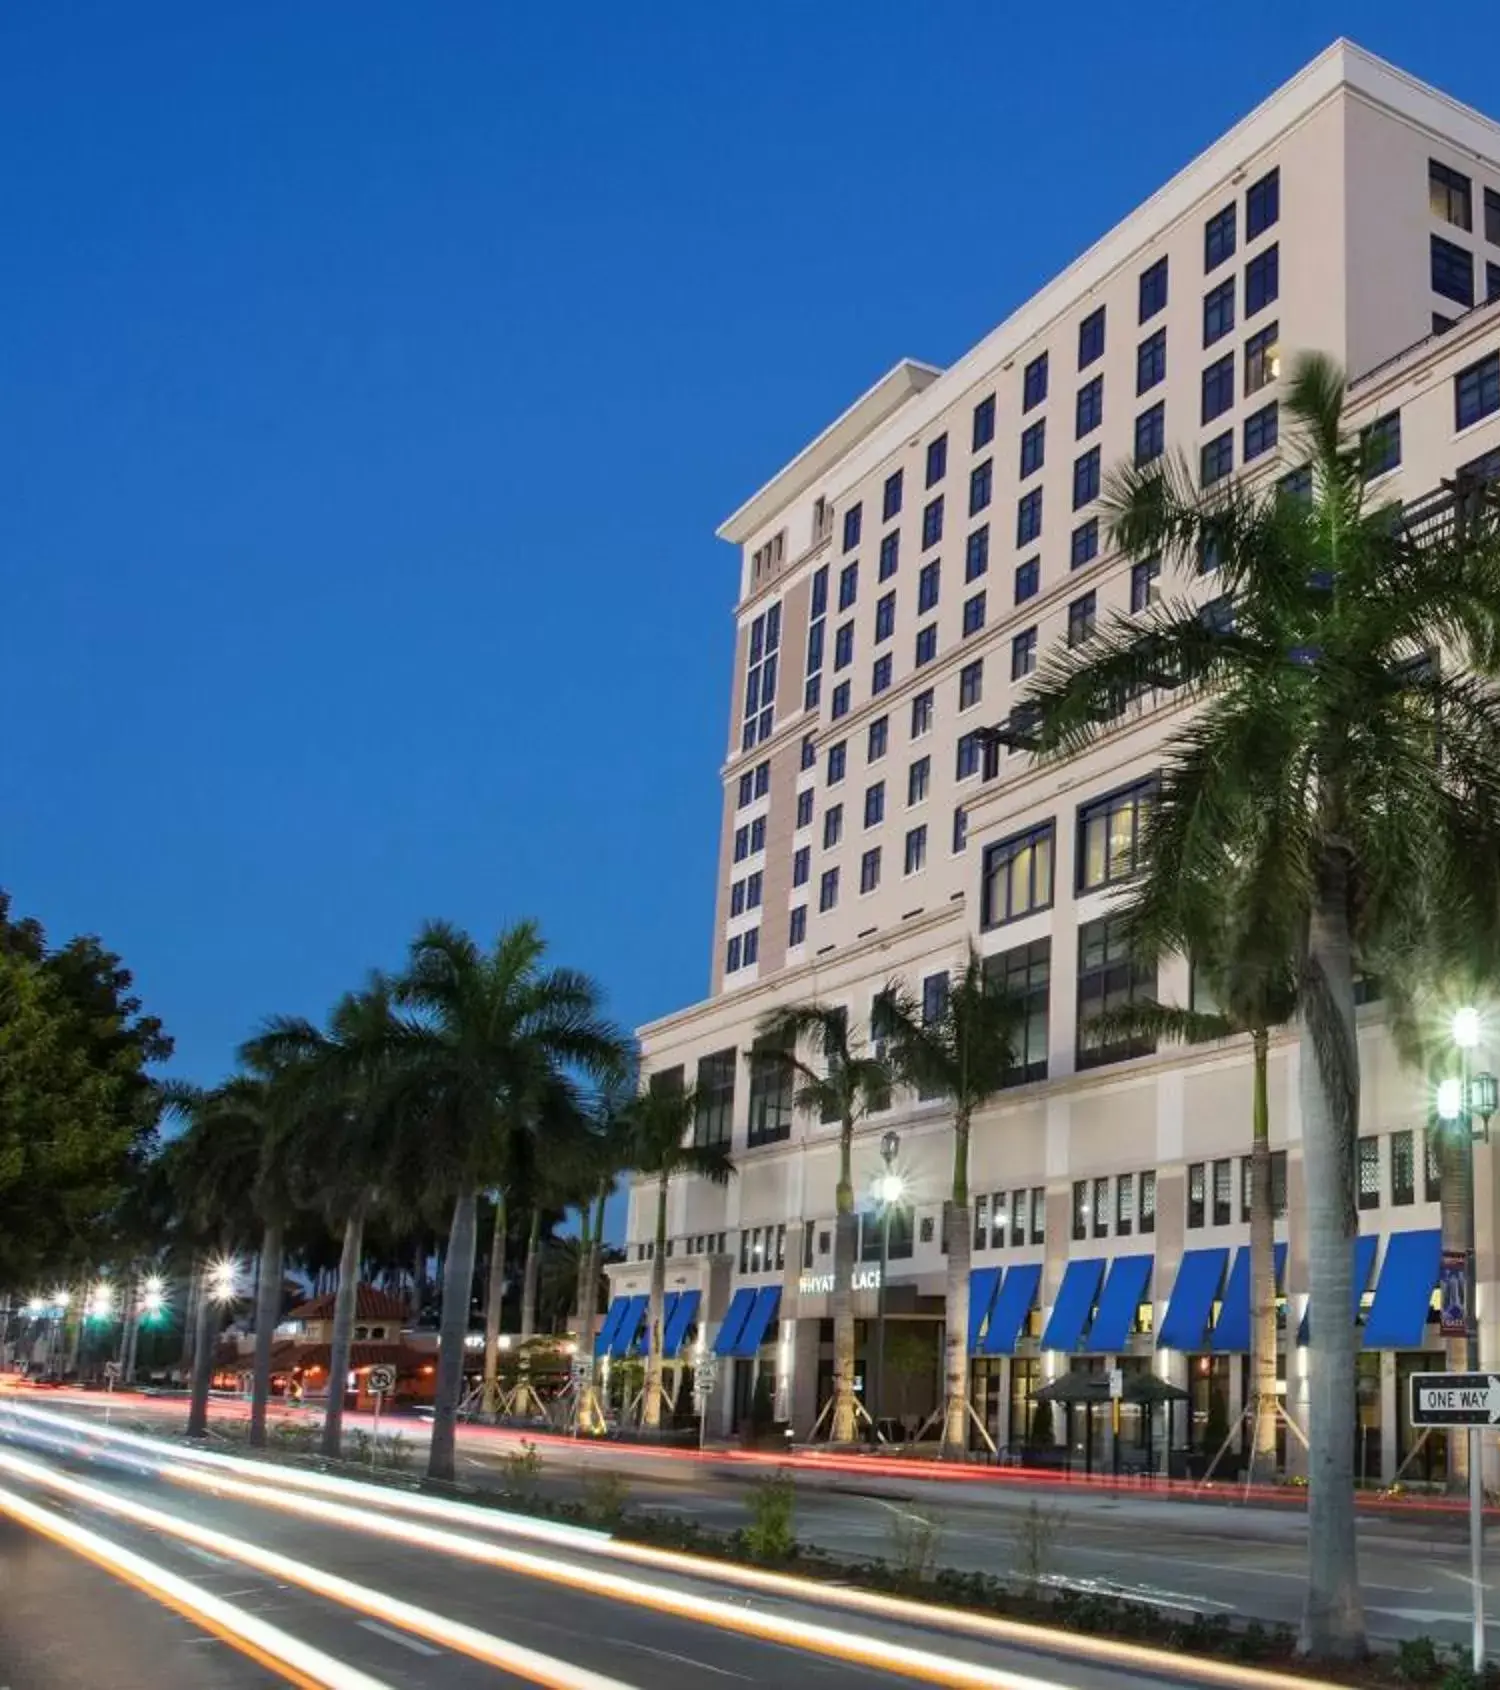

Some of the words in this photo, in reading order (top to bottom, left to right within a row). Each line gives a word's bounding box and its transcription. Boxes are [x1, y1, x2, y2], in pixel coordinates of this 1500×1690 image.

[807, 1274, 835, 1294] HYAT
[851, 1269, 881, 1292] LACE
[1427, 1391, 1456, 1408] ONE
[1459, 1391, 1488, 1408] WAY
